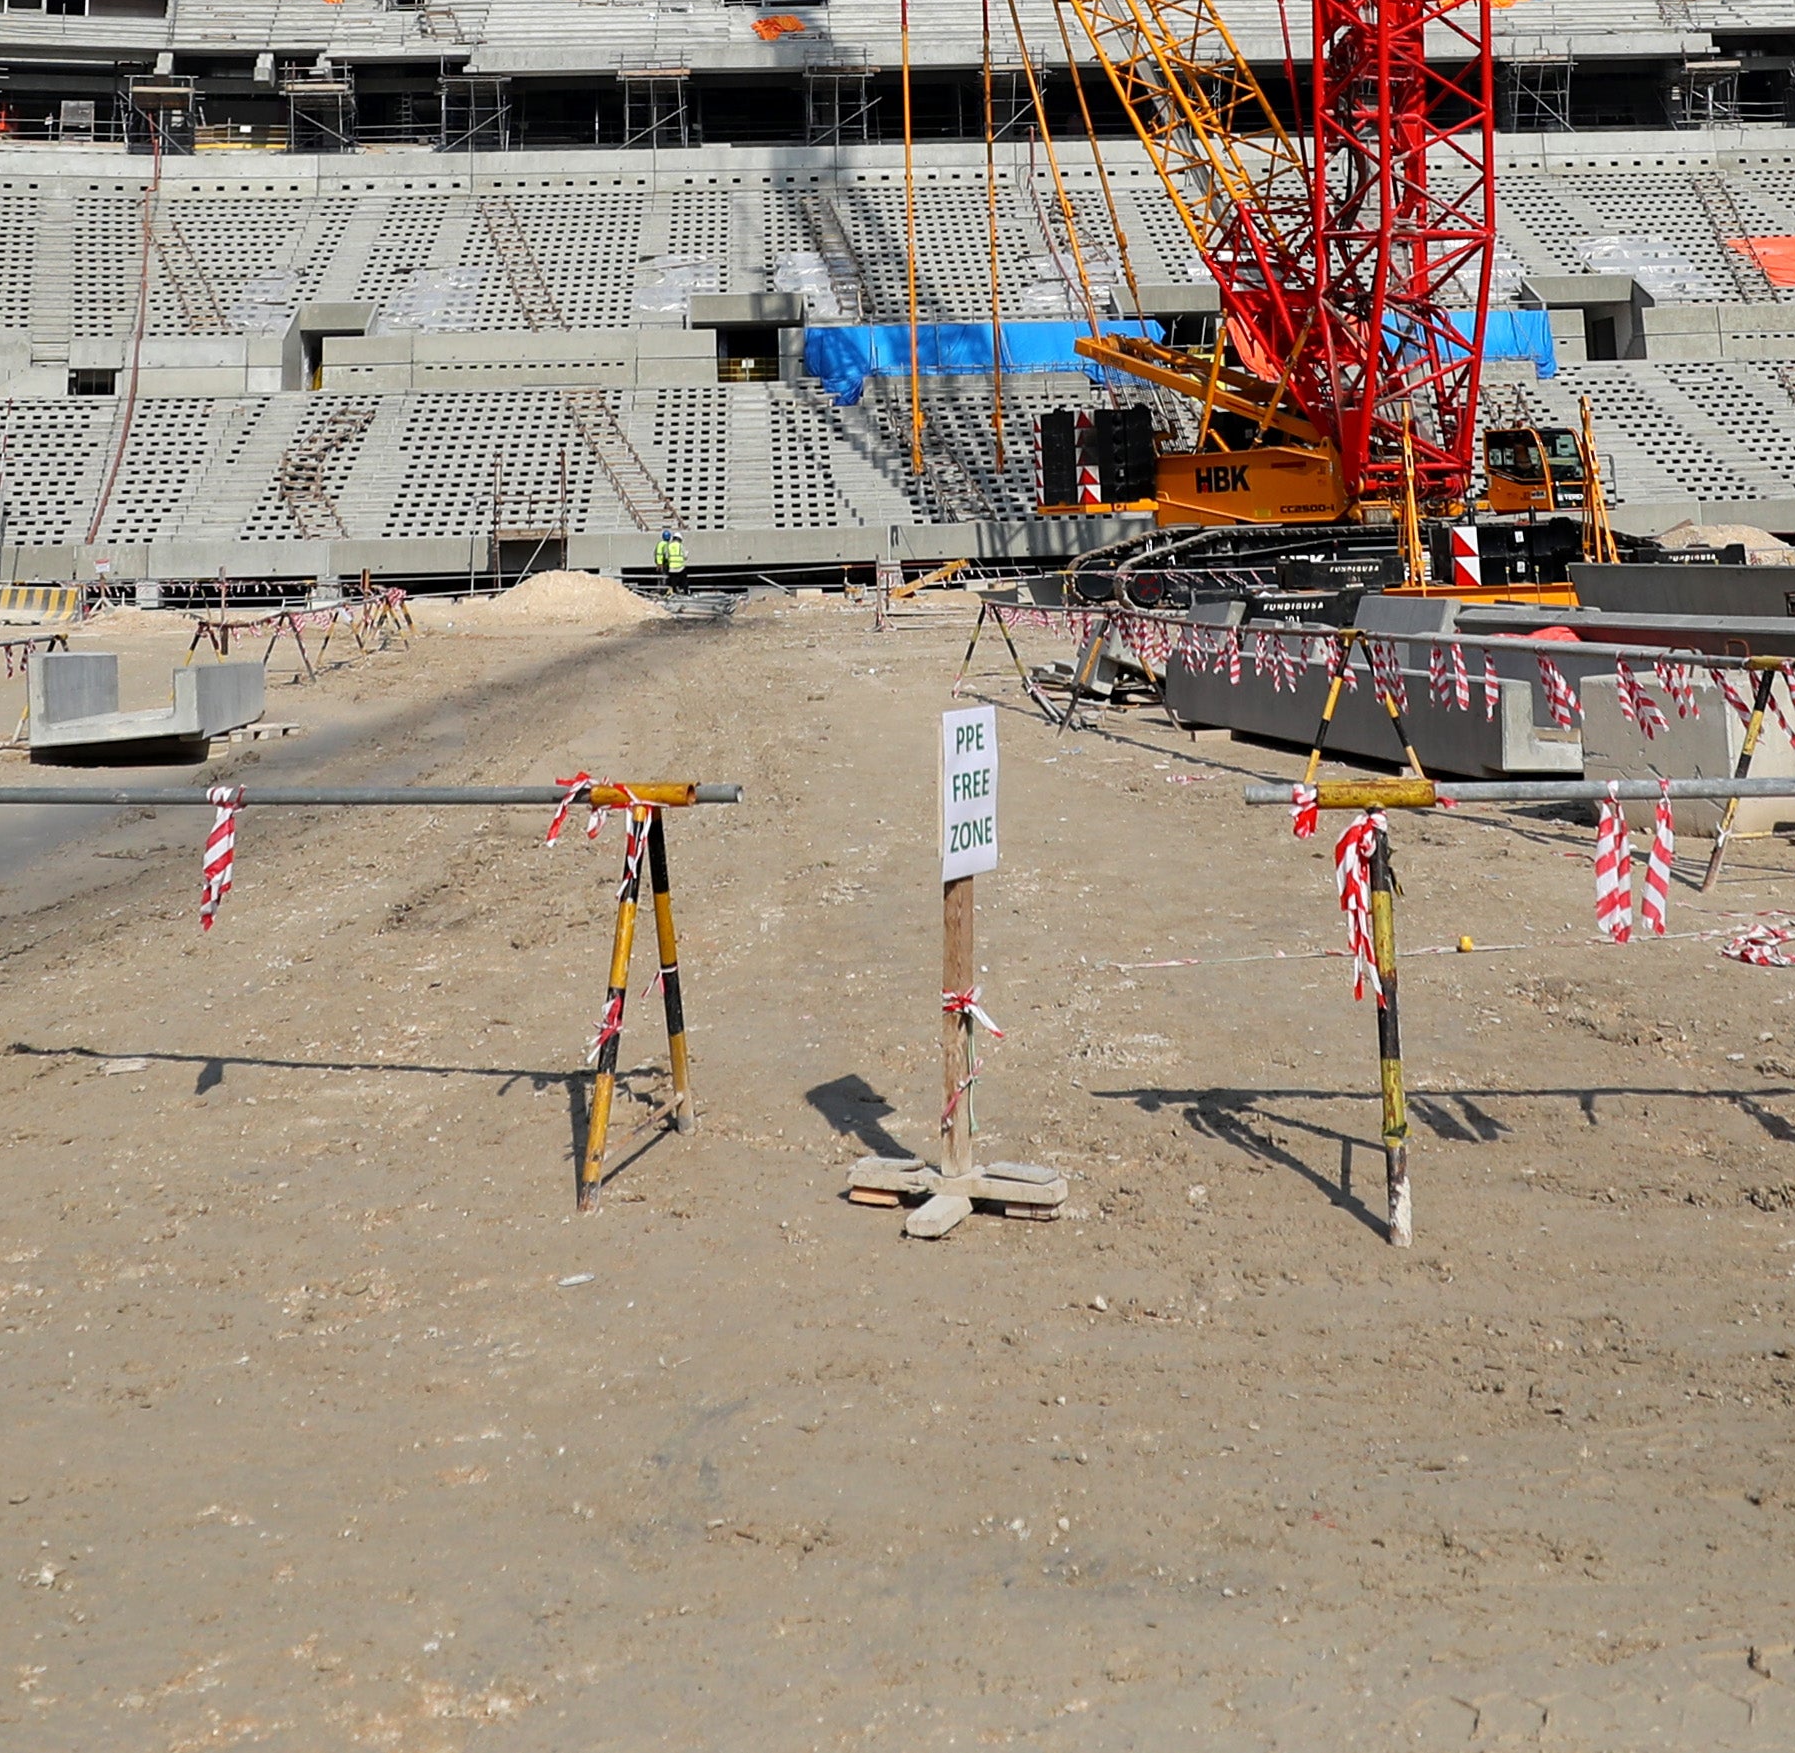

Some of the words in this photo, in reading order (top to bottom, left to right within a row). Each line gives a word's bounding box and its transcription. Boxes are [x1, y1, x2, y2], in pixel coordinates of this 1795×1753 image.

[1195, 464, 1251, 494] HBK
[1263, 602, 1324, 612] FUNDIGUSA
[956, 723, 985, 755] PPE
[952, 768, 991, 802] FREE
[950, 816, 993, 853] ZONE
